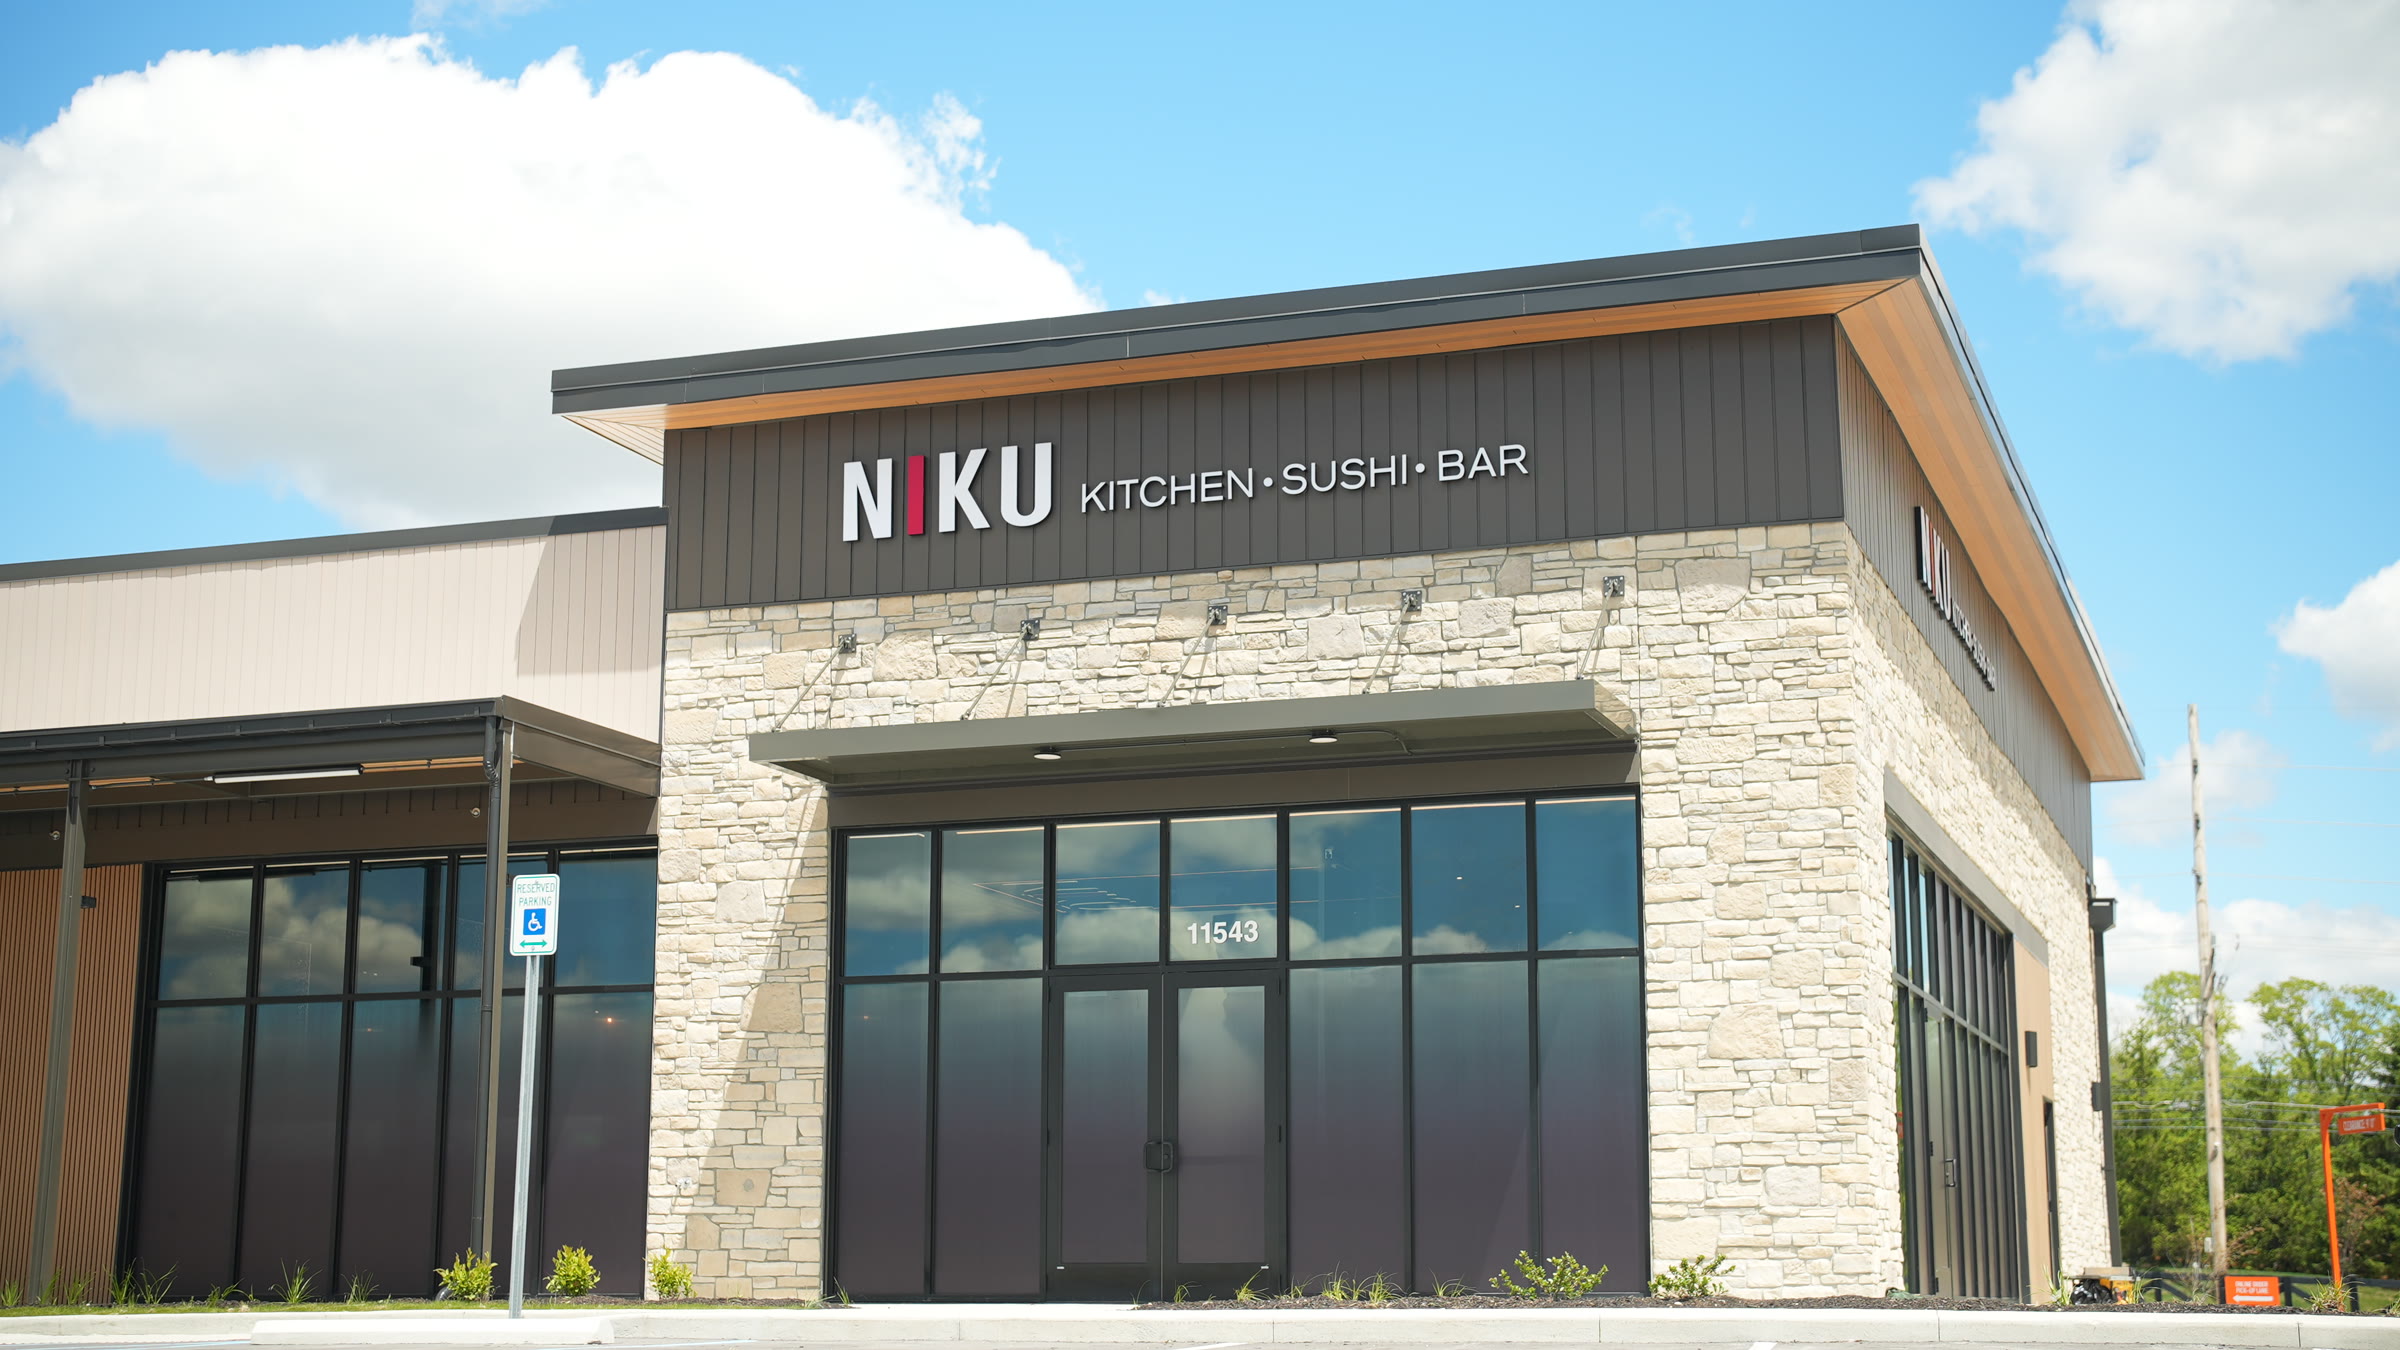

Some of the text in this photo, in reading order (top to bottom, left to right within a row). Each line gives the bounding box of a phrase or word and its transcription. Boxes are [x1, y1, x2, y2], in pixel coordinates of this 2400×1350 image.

[842, 442, 1052, 542] NIKU
[1081, 444, 1529, 513] KITCHEN SUSHI BAR
[1915, 506, 1951, 621] NIKU
[517, 883, 555, 893] RESERVED
[519, 896, 552, 907] PARKING
[1187, 920, 1259, 944] 11543
